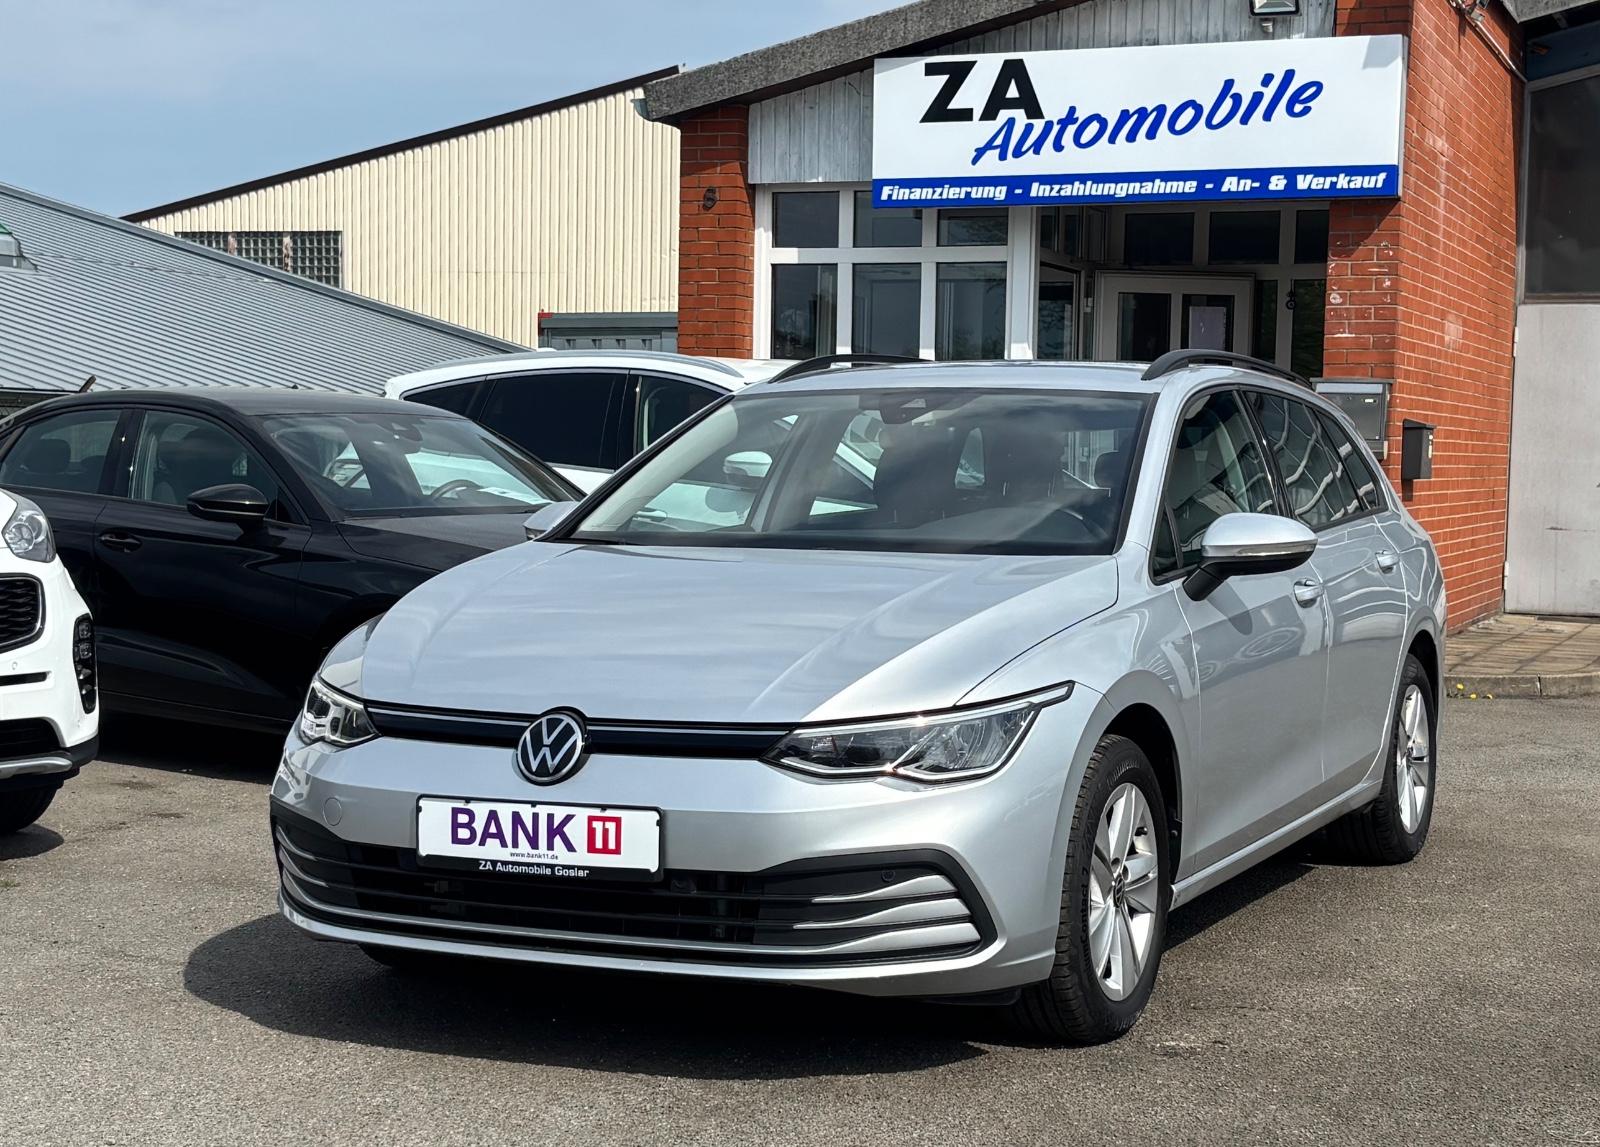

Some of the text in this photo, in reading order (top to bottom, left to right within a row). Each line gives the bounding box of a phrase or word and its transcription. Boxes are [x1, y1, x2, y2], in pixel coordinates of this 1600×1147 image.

[919, 58, 1046, 124] ZA
[971, 69, 1324, 166] Automobile
[880, 184, 1008, 200] Finanzierung
[1029, 178, 1198, 197] Inzahlungnahme
[1220, 176, 1261, 192] An-
[1268, 174, 1288, 191] &
[1296, 172, 1388, 190] Verkauf
[521, 715, 581, 778] VW
[450, 806, 617, 853] BANK 11
[478, 860, 590, 877] ZA Automobile Goslar
[509, 851, 559, 861] www.bank11.de
